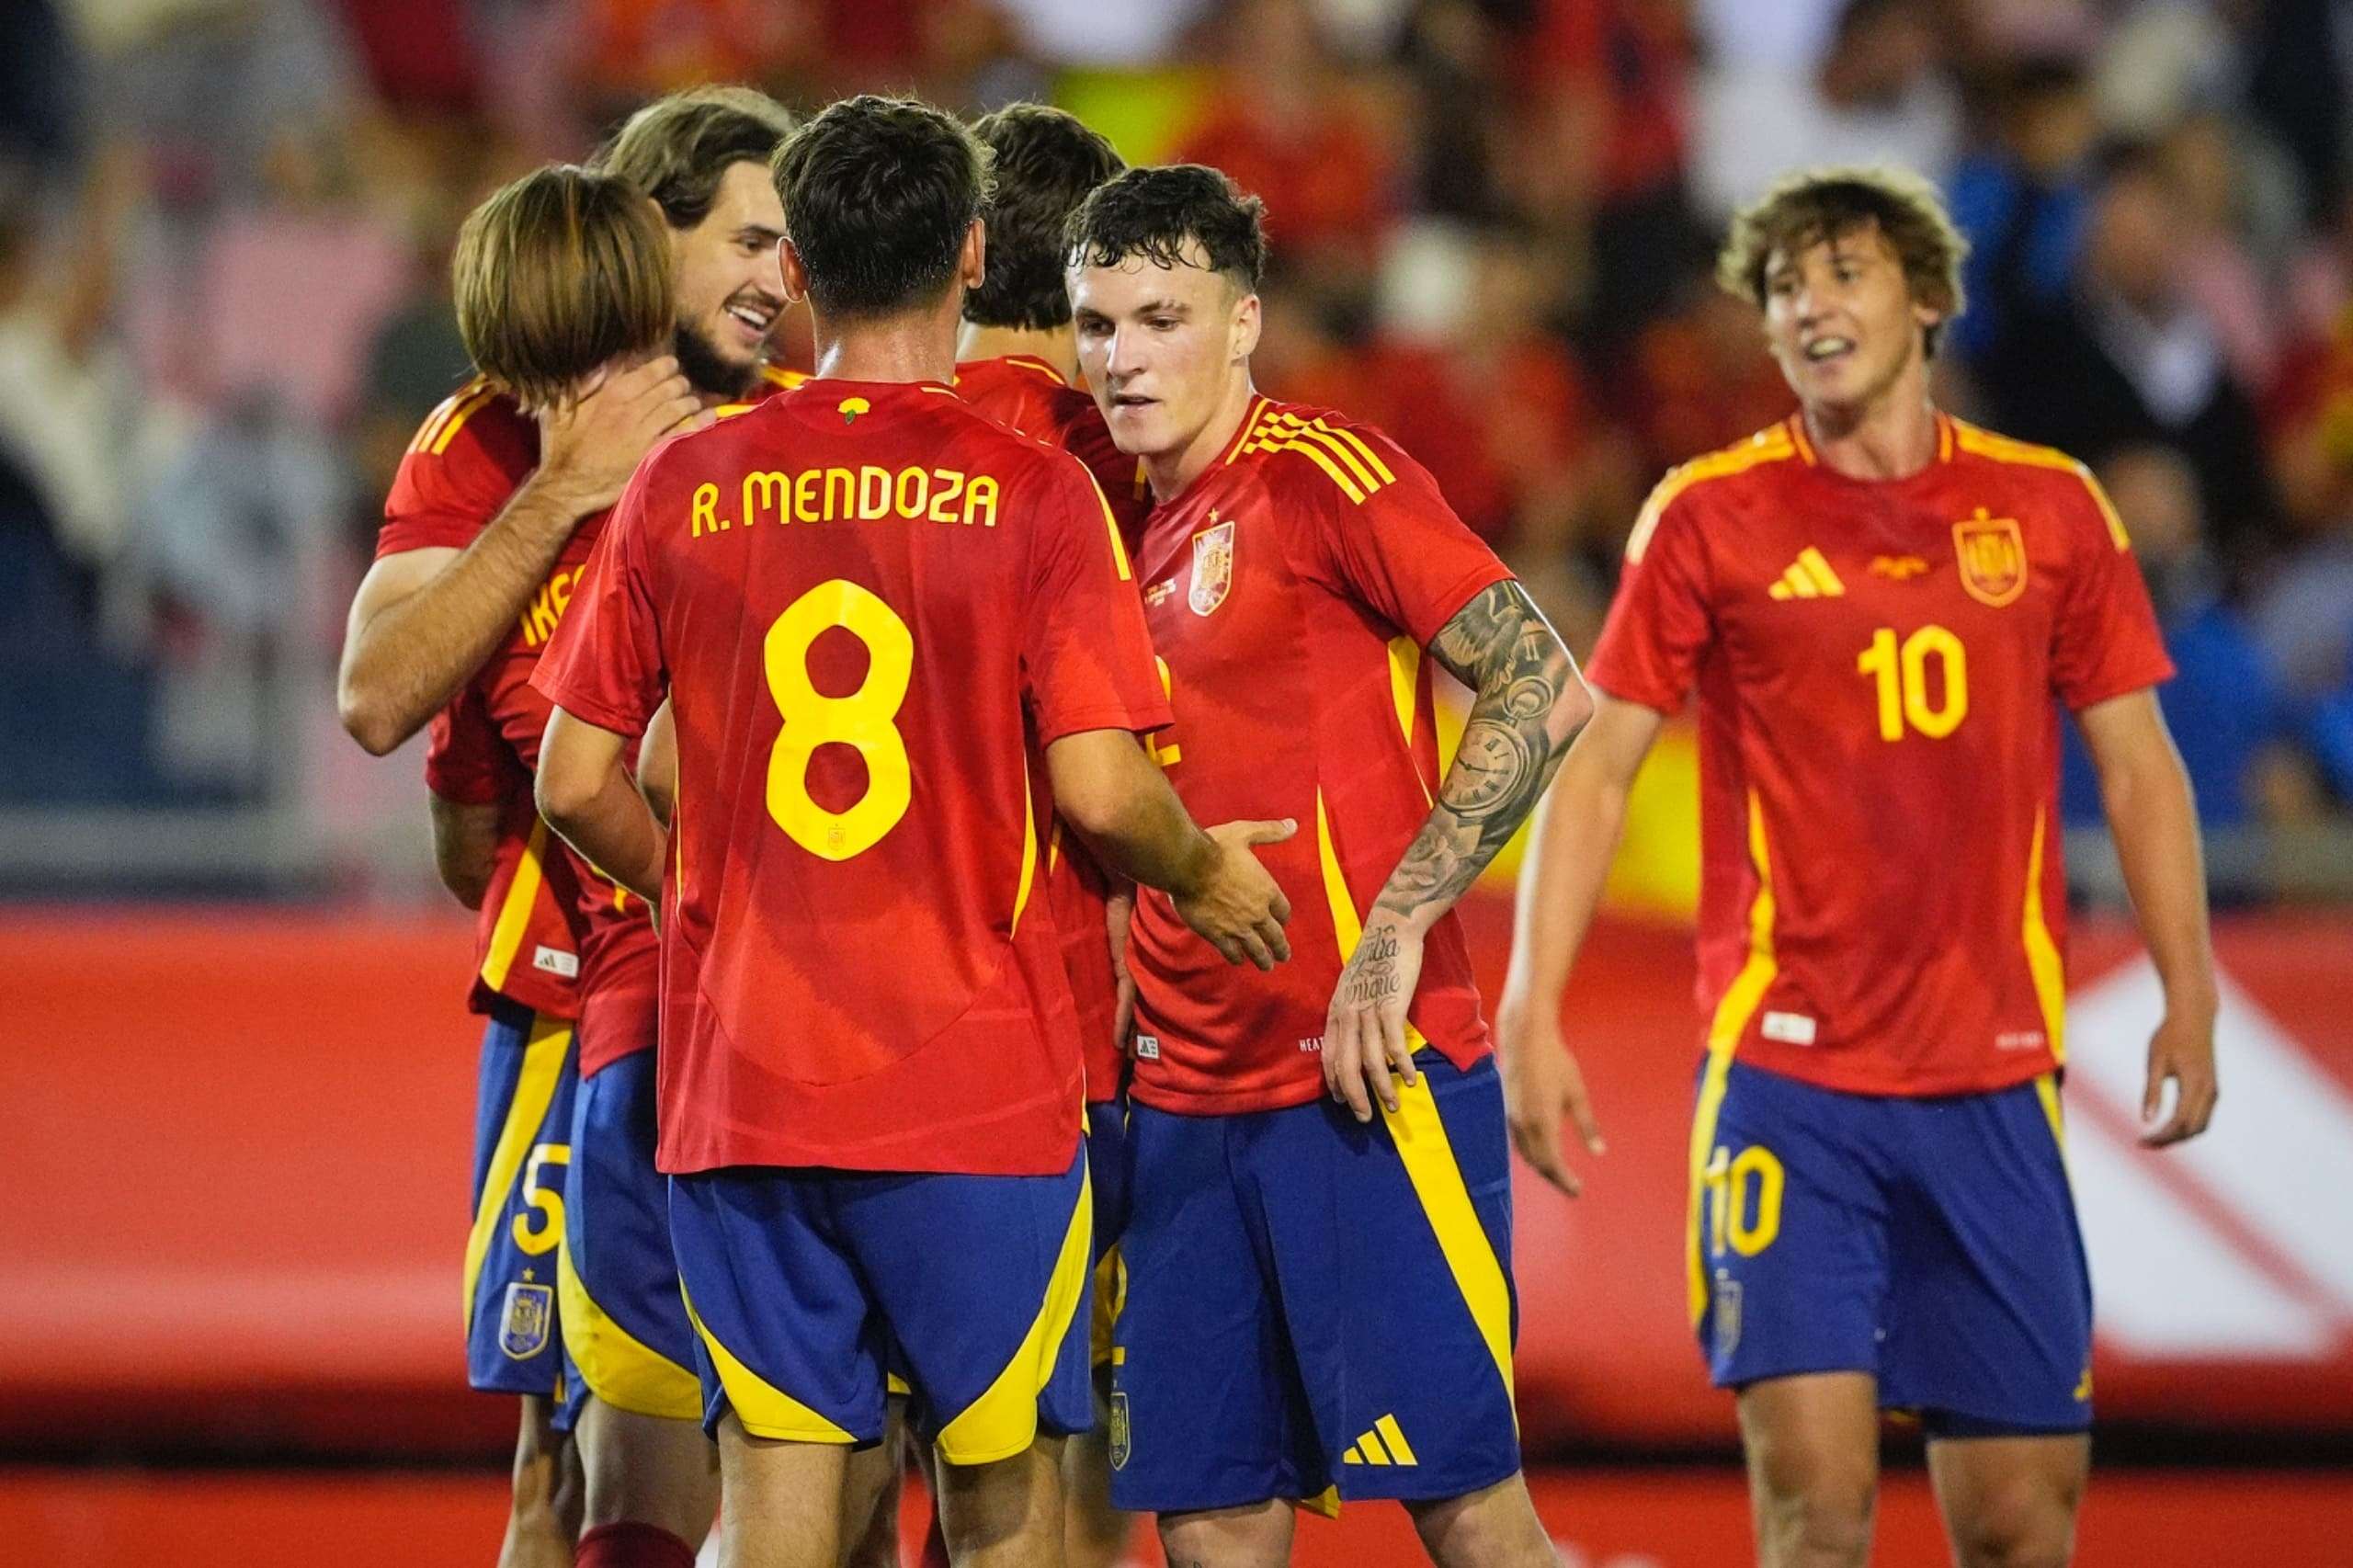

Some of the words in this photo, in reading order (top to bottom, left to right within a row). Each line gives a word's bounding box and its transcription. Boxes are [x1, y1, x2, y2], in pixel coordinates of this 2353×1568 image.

[692, 483, 731, 538] R.
[743, 466, 1000, 527] MENDOZA
[764, 578, 915, 862] 8
[1857, 624, 1969, 742] 10
[511, 1143, 572, 1256] 5
[1705, 1145, 1785, 1257] 10
